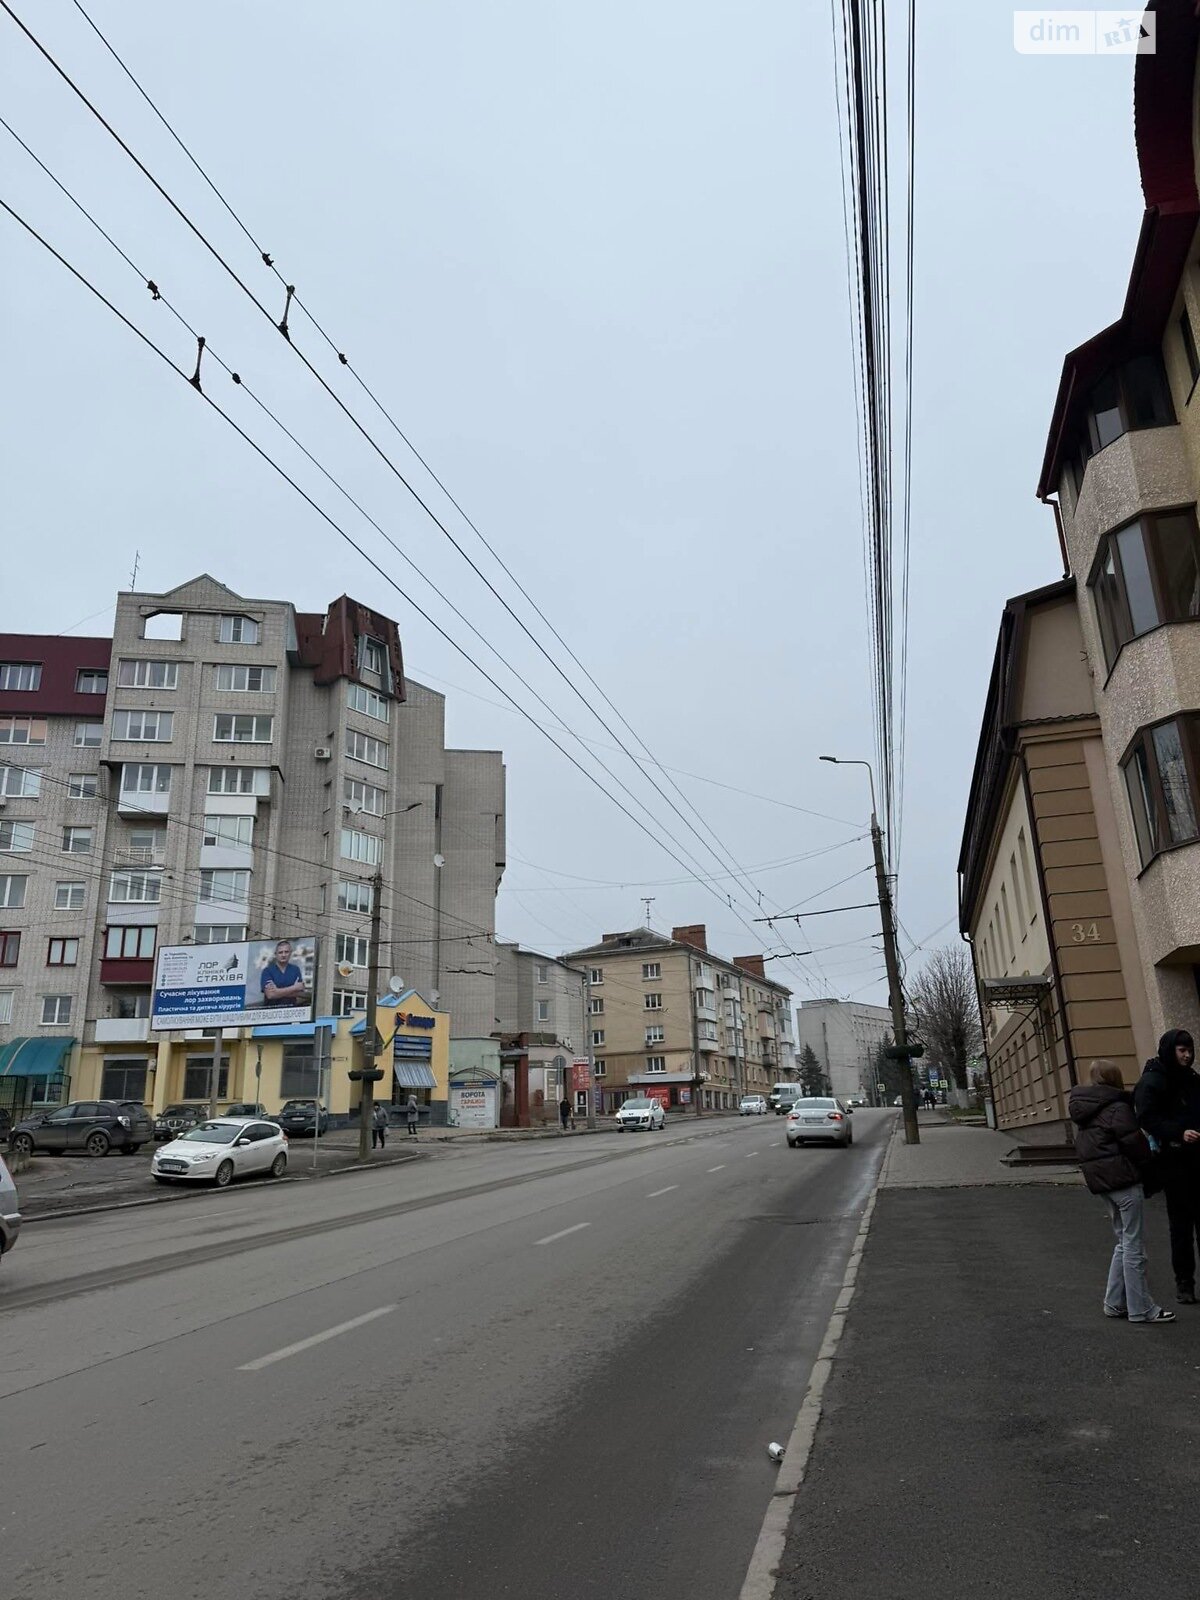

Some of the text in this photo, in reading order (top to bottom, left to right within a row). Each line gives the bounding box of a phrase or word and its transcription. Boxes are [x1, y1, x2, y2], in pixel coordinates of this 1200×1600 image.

[1072, 923, 1100, 942] 34
[198, 962, 219, 970] ЛОР
[160, 989, 221, 999] Сучасне лікування
[198, 995, 242, 1003] захворювань
[219, 1002, 242, 1011] хірургія
